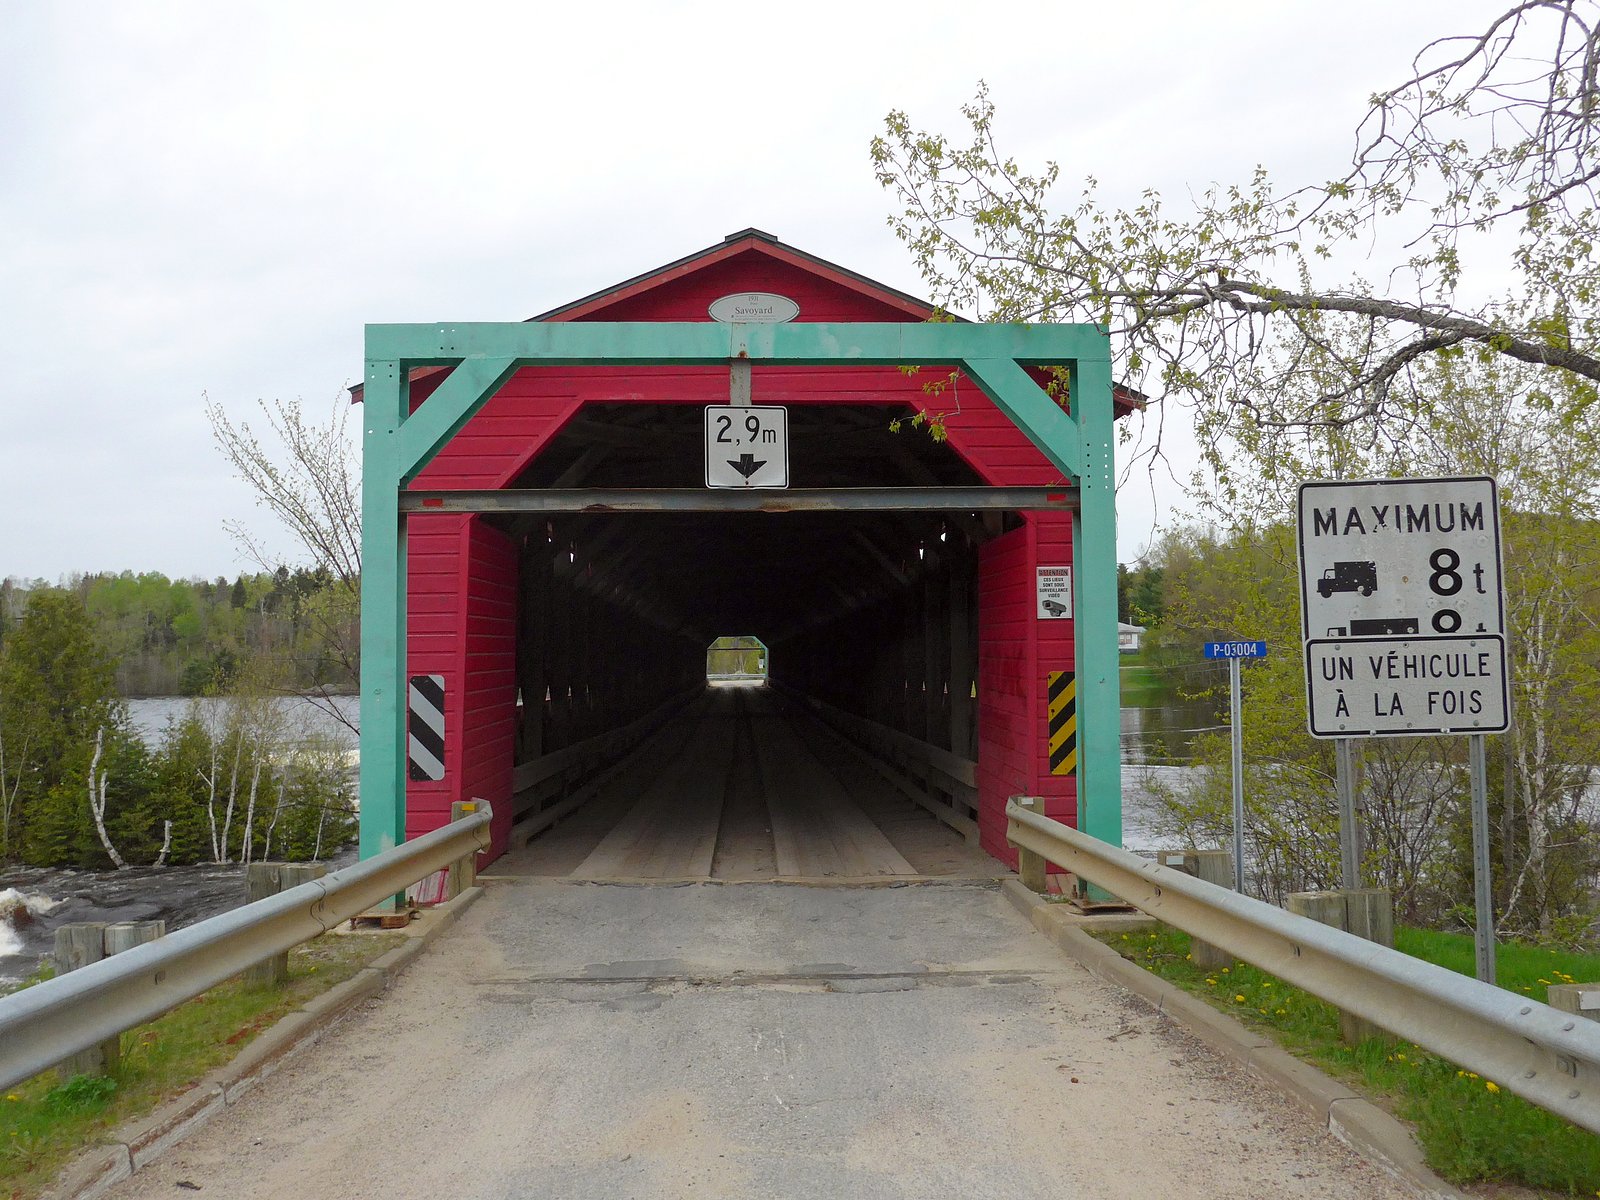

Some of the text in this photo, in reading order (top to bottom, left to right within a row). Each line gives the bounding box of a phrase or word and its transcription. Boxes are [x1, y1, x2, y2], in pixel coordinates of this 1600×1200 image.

[735, 306, 773, 315] Savoyard
[1313, 502, 1484, 536] MAXIMUM
[1428, 548, 1487, 596] 8 t
[1213, 643, 1257, 656] P-03004
[1322, 651, 1491, 681] UN VÉHICULE
[1335, 689, 1482, 717] À LA FOIS
